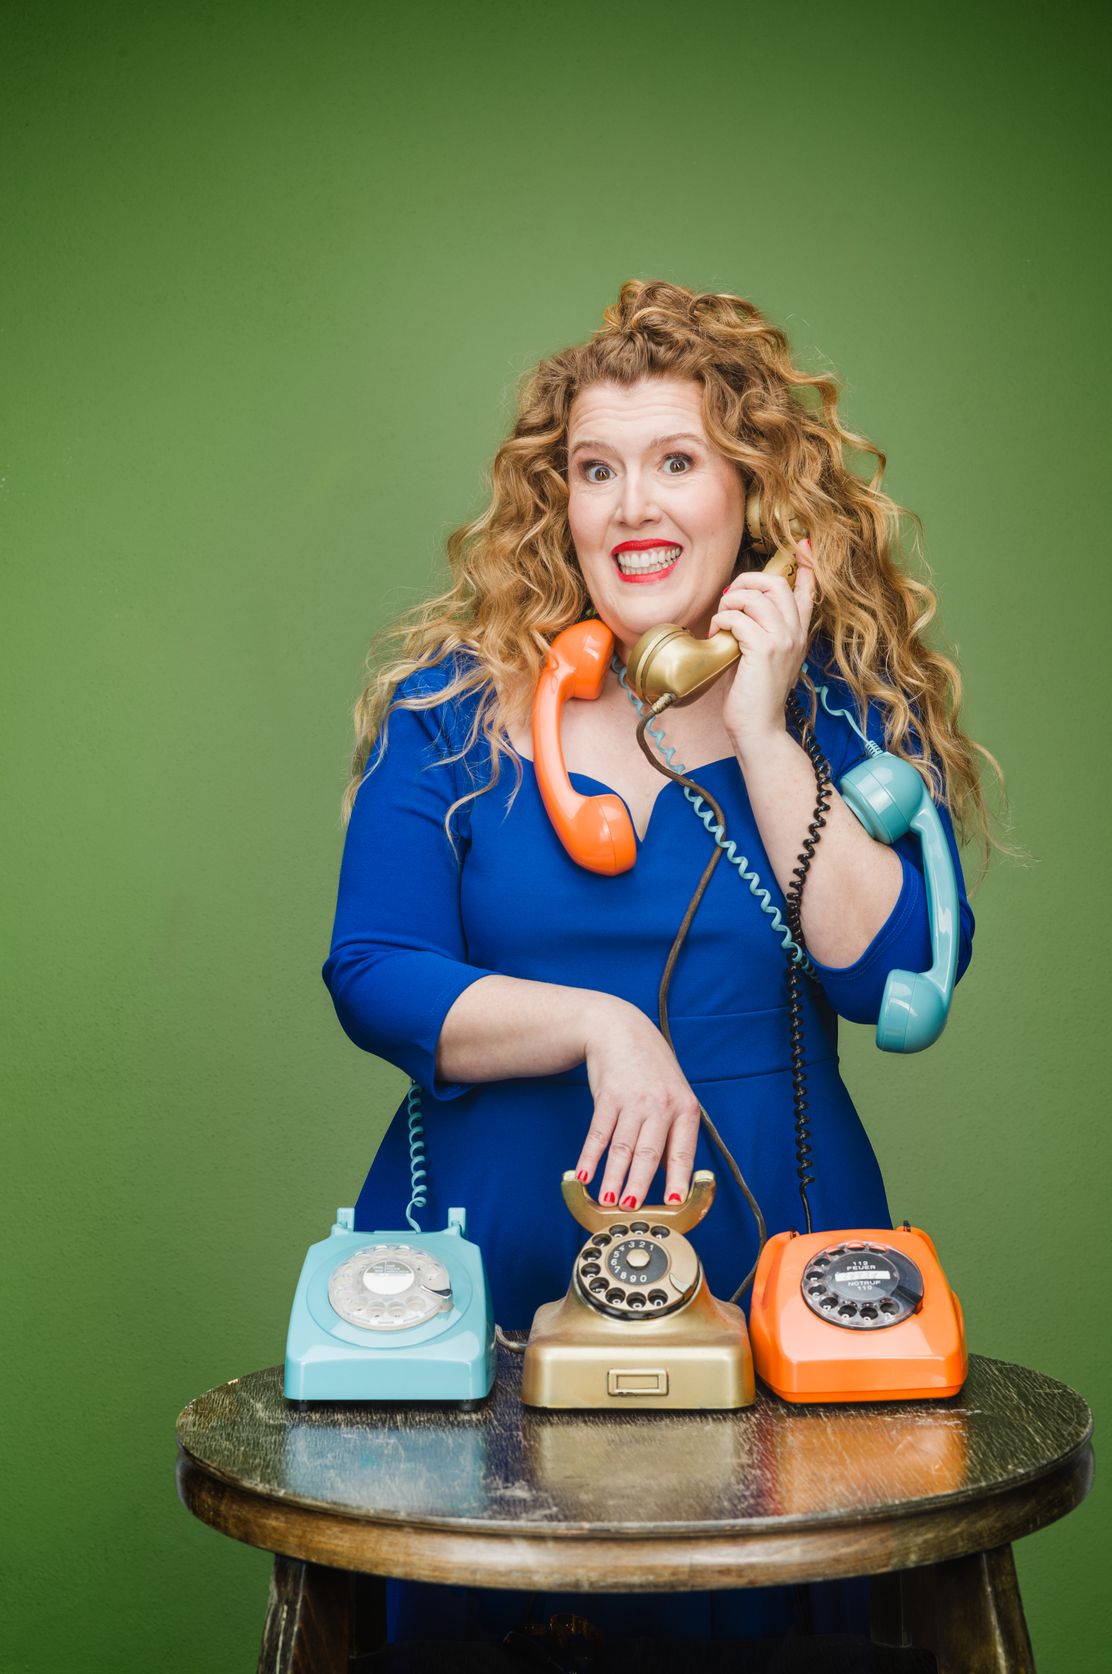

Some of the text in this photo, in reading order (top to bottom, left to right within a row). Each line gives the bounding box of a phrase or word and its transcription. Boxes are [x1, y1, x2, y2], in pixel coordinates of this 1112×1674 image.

[613, 1250, 620, 1258] 5
[614, 1265, 620, 1273] 7
[620, 1271, 627, 1280] 8
[630, 1274, 637, 1282] 9
[640, 1274, 647, 1282] 0
